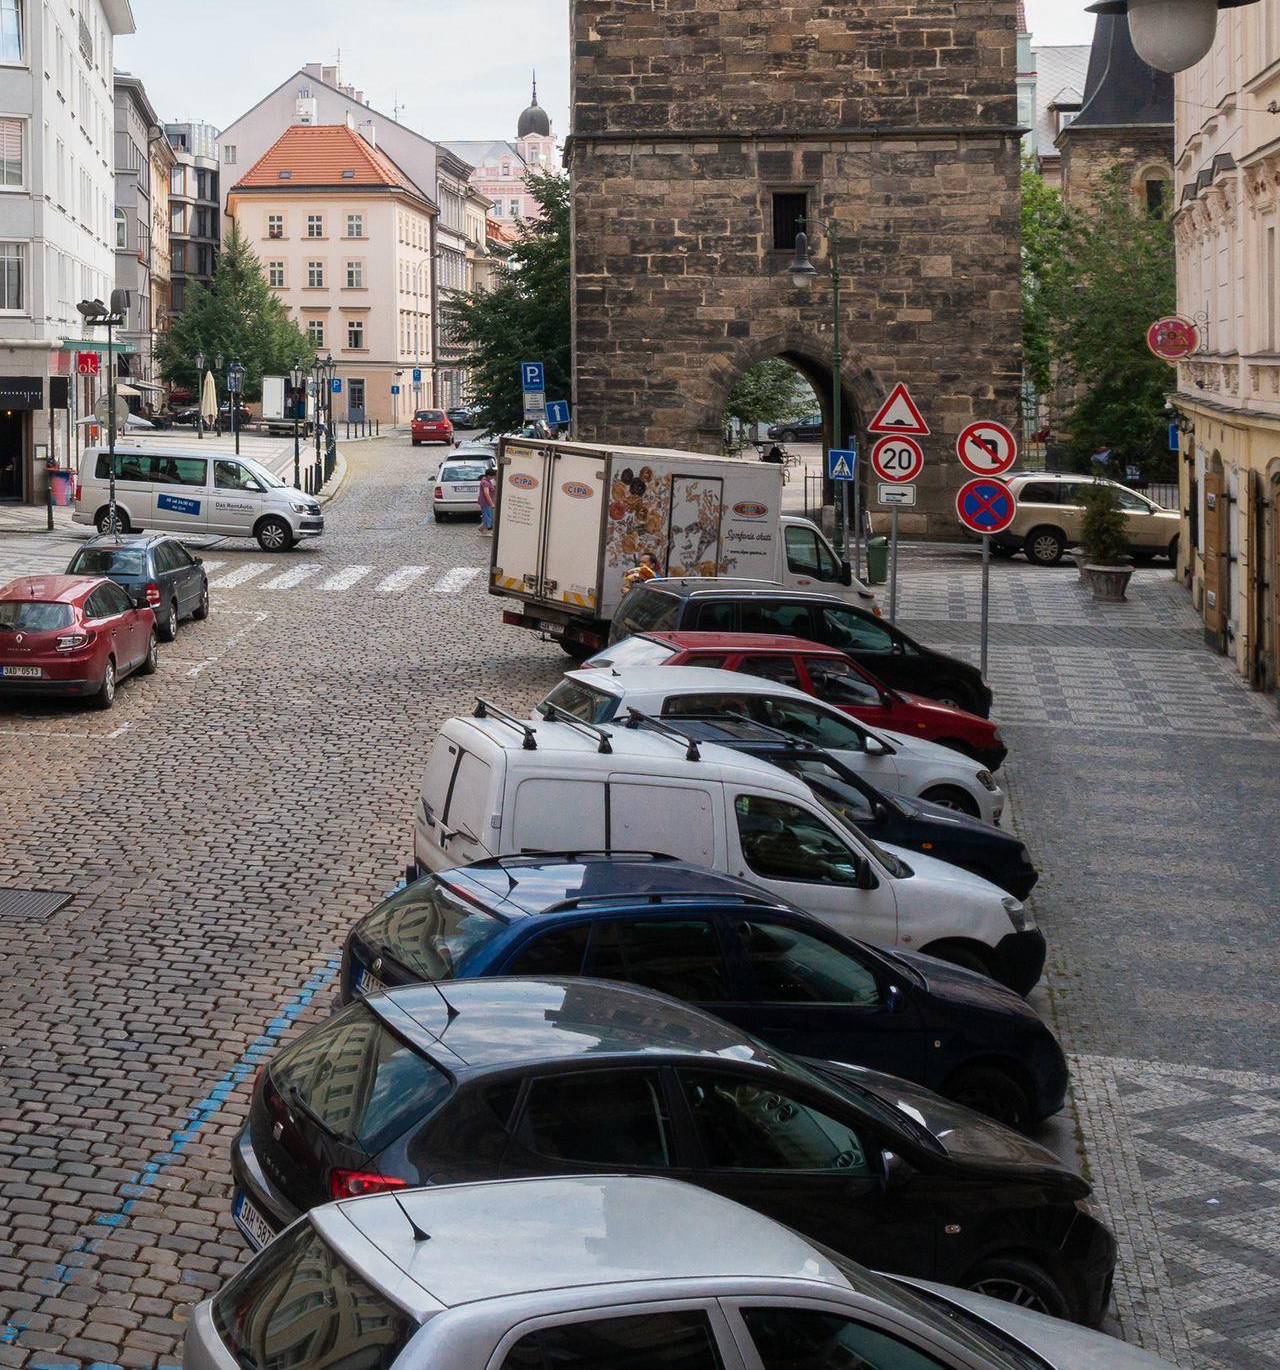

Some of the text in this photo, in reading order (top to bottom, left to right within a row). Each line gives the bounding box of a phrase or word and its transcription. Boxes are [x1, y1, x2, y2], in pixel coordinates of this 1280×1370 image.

[79, 359, 97, 374] ok
[527, 367, 538, 382] P
[333, 380, 339, 389] P
[883, 448, 911, 470] 20
[515, 477, 532, 486] CIPA
[568, 486, 587, 495] CIPA
